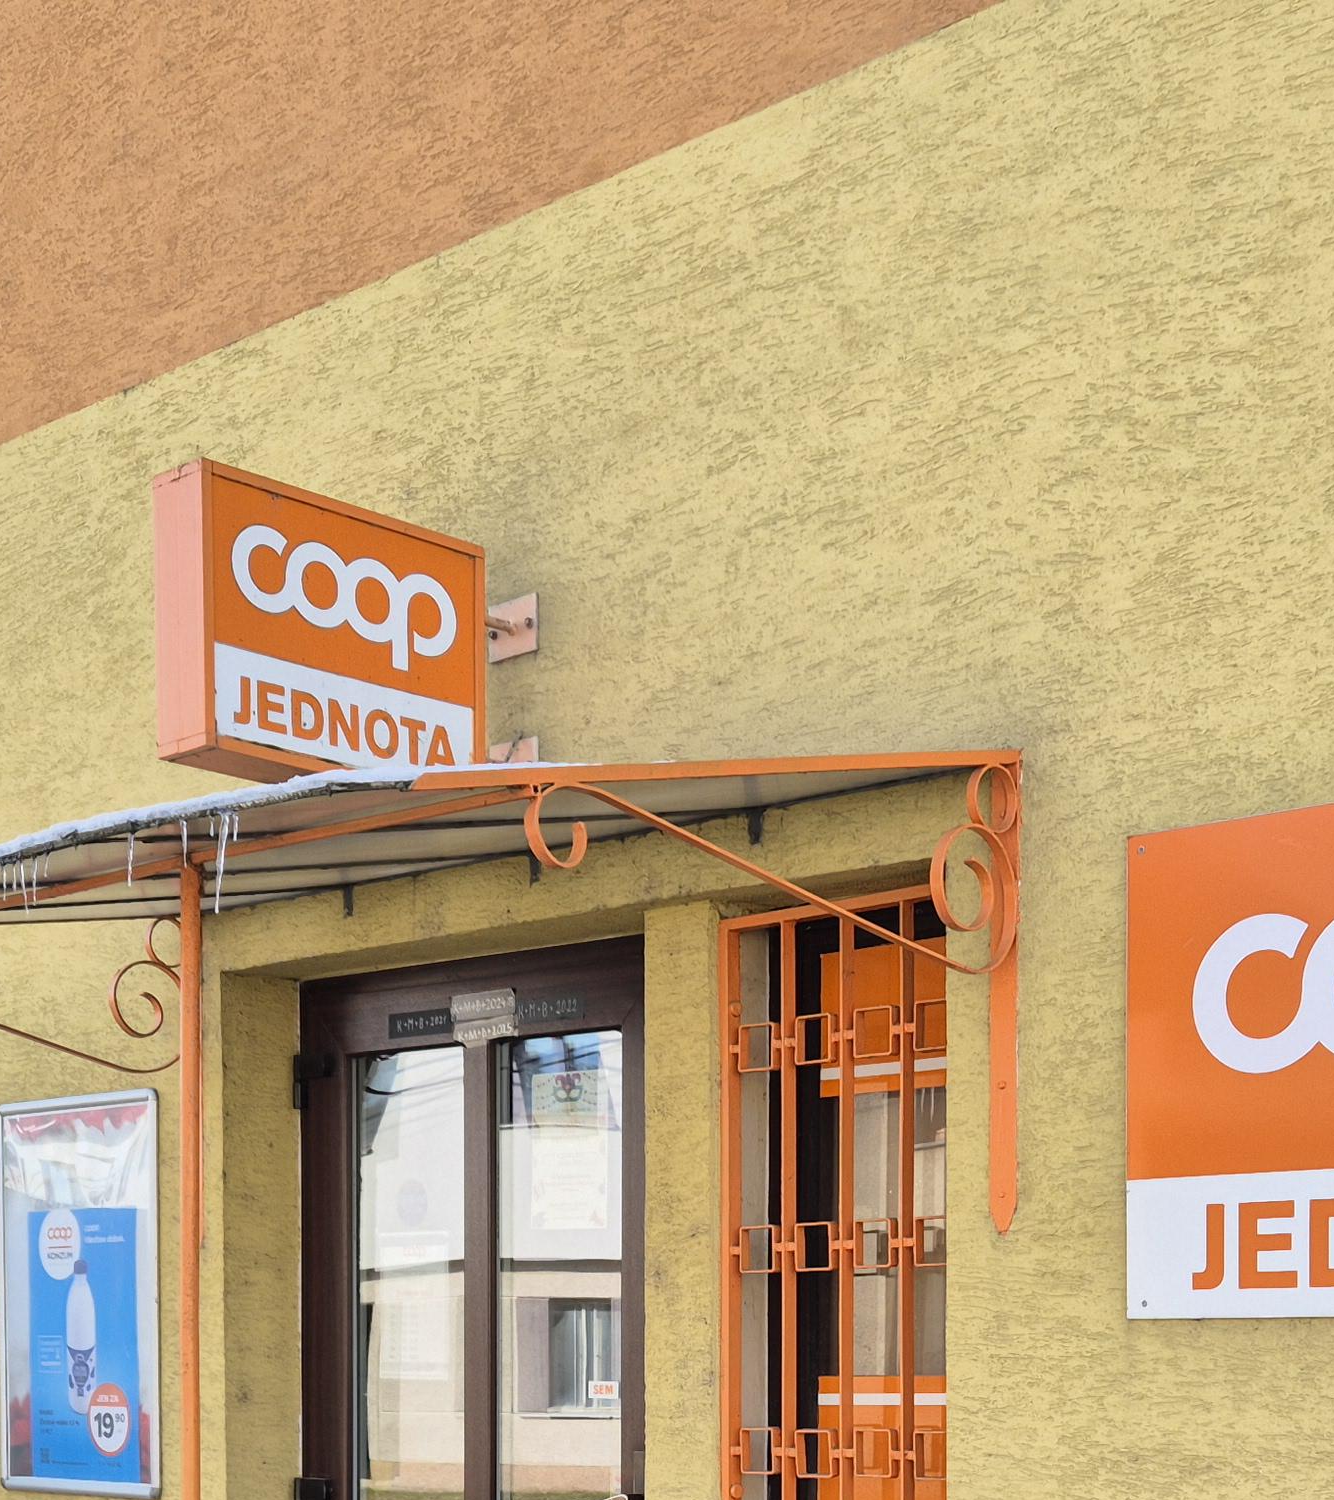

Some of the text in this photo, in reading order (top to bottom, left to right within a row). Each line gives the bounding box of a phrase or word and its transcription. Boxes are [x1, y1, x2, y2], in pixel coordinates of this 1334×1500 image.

[231, 524, 457, 672] coop
[233, 676, 455, 767] JEDNOTA
[593, 1384, 613, 1395] SEM
[94, 1412, 114, 1439] 19
